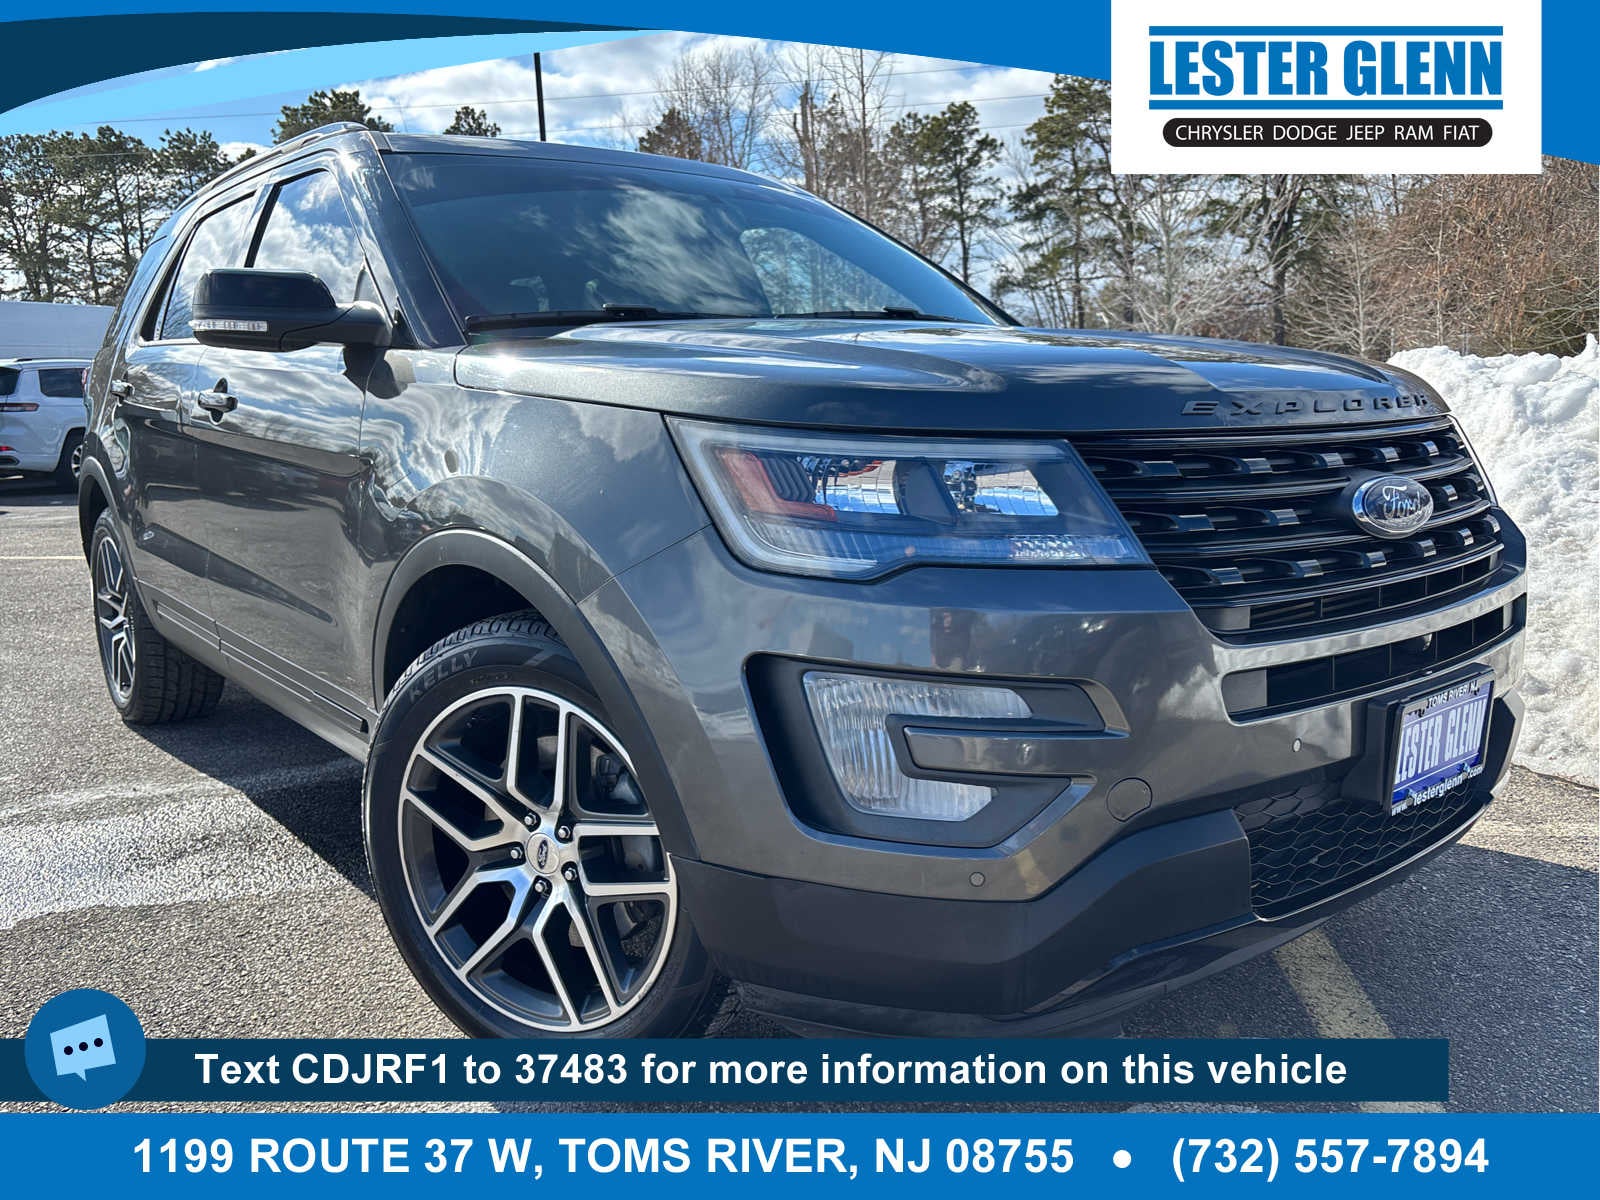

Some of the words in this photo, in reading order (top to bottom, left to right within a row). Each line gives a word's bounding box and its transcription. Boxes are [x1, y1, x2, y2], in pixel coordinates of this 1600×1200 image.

[1181, 394, 1429, 416] EXPLORER
[1382, 485, 1421, 520] Ford
[408, 649, 480, 704] KELLY
[1427, 690, 1449, 708] TOMS
[1395, 714, 1443, 785] LESTER
[1444, 698, 1488, 762] GLENN
